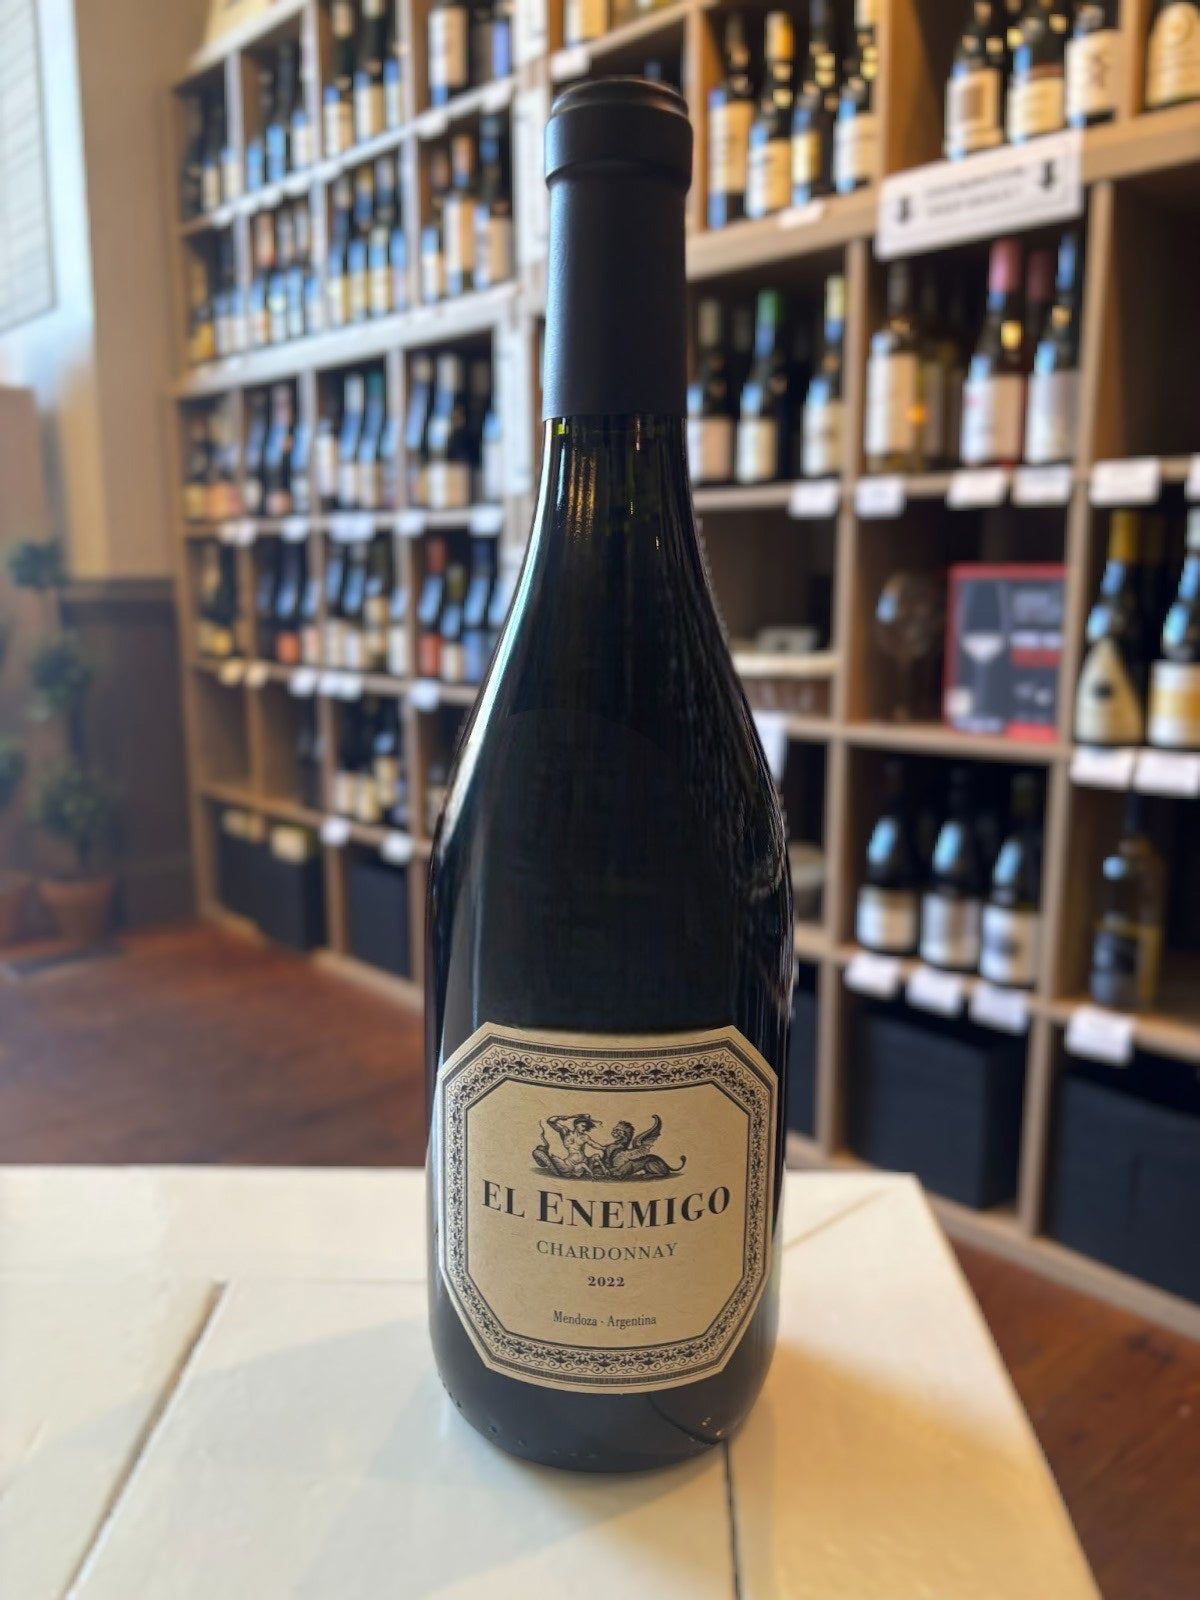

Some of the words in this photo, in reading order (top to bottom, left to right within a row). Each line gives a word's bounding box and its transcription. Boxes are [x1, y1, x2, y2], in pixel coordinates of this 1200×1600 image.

[482, 1178, 526, 1218] EL
[537, 1186, 731, 1229] ENEMIGO
[536, 1239, 678, 1261] CHARDONNAY
[587, 1275, 625, 1287] 2022
[553, 1310, 597, 1326] Mendoza
[607, 1314, 657, 1330] Argentina
